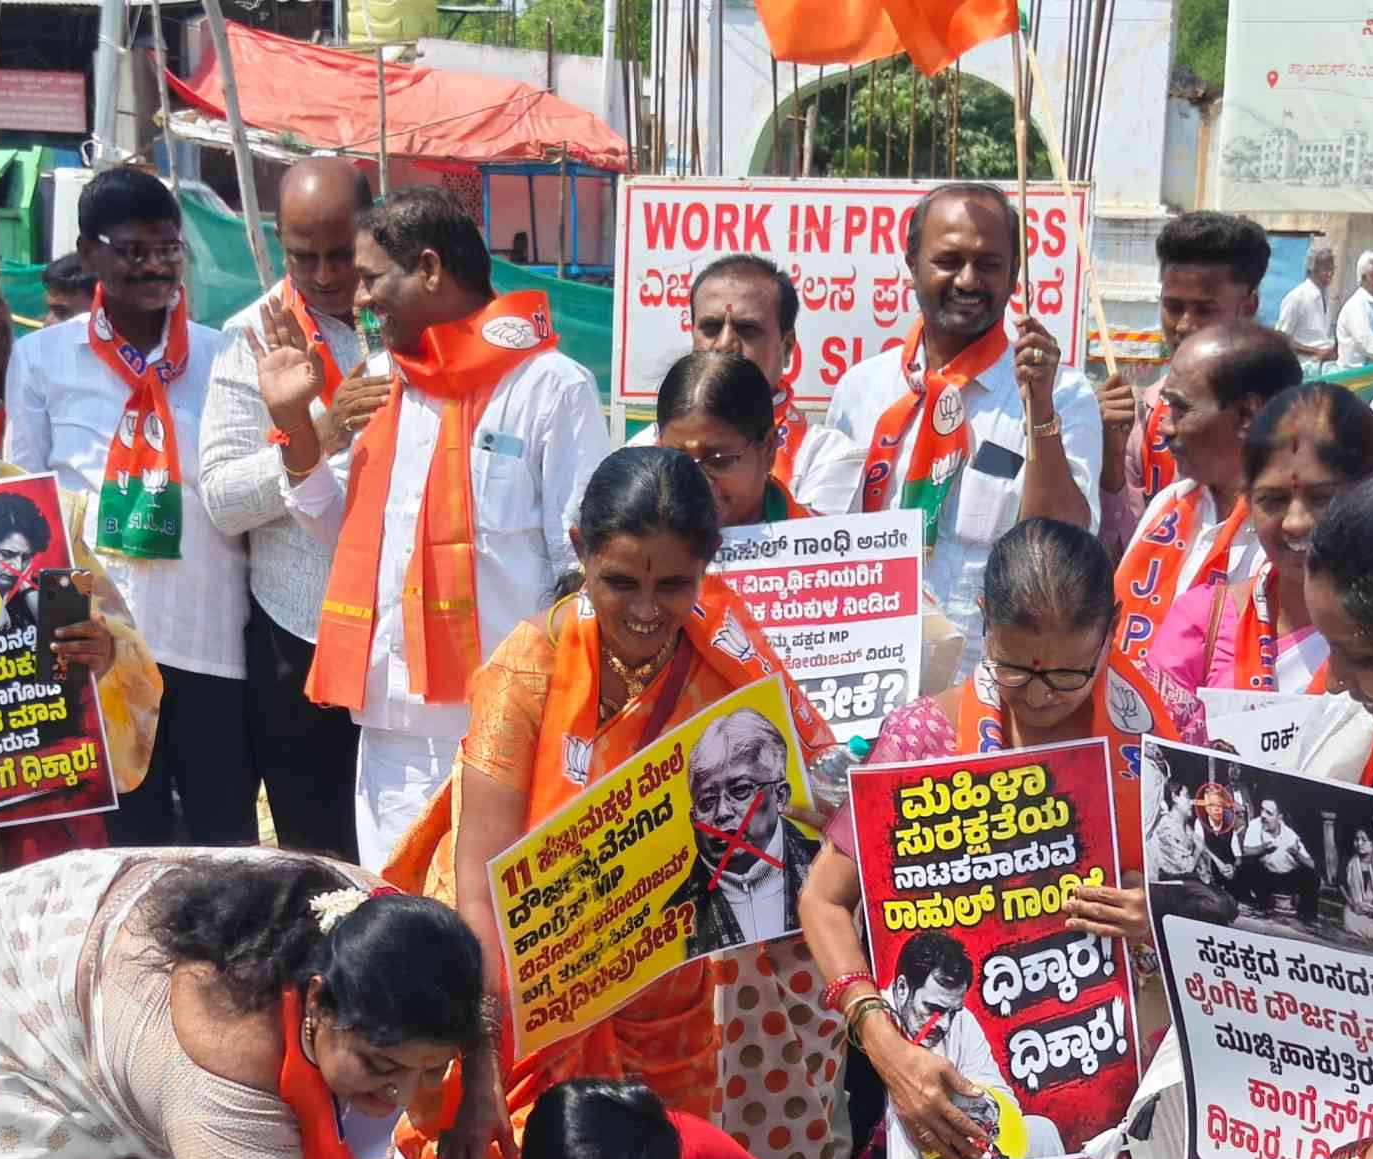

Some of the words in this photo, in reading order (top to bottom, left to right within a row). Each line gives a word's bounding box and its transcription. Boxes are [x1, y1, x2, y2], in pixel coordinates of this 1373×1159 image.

[642, 202, 773, 252] WORK
[788, 204, 833, 253] IN
[793, 529, 851, 558] ಗಾಂಧಿ
[857, 528, 908, 549] ಅವರೇ
[829, 630, 849, 643] MP
[899, 763, 1047, 821] ಮಹಿಳಾ
[895, 797, 1070, 857] ಸುರಕ್ಷತೆಯ
[500, 856, 533, 898] 11
[593, 864, 626, 904] MP
[893, 834, 1077, 891] ನಾಟಕವಾಡುವ
[883, 883, 995, 931] ರಾಹುಲ್
[1196, 935, 1280, 985] ಸ್ವಪಕ್ಷದ
[1185, 972, 1258, 1019] ಲೈಂಗಿಕ
